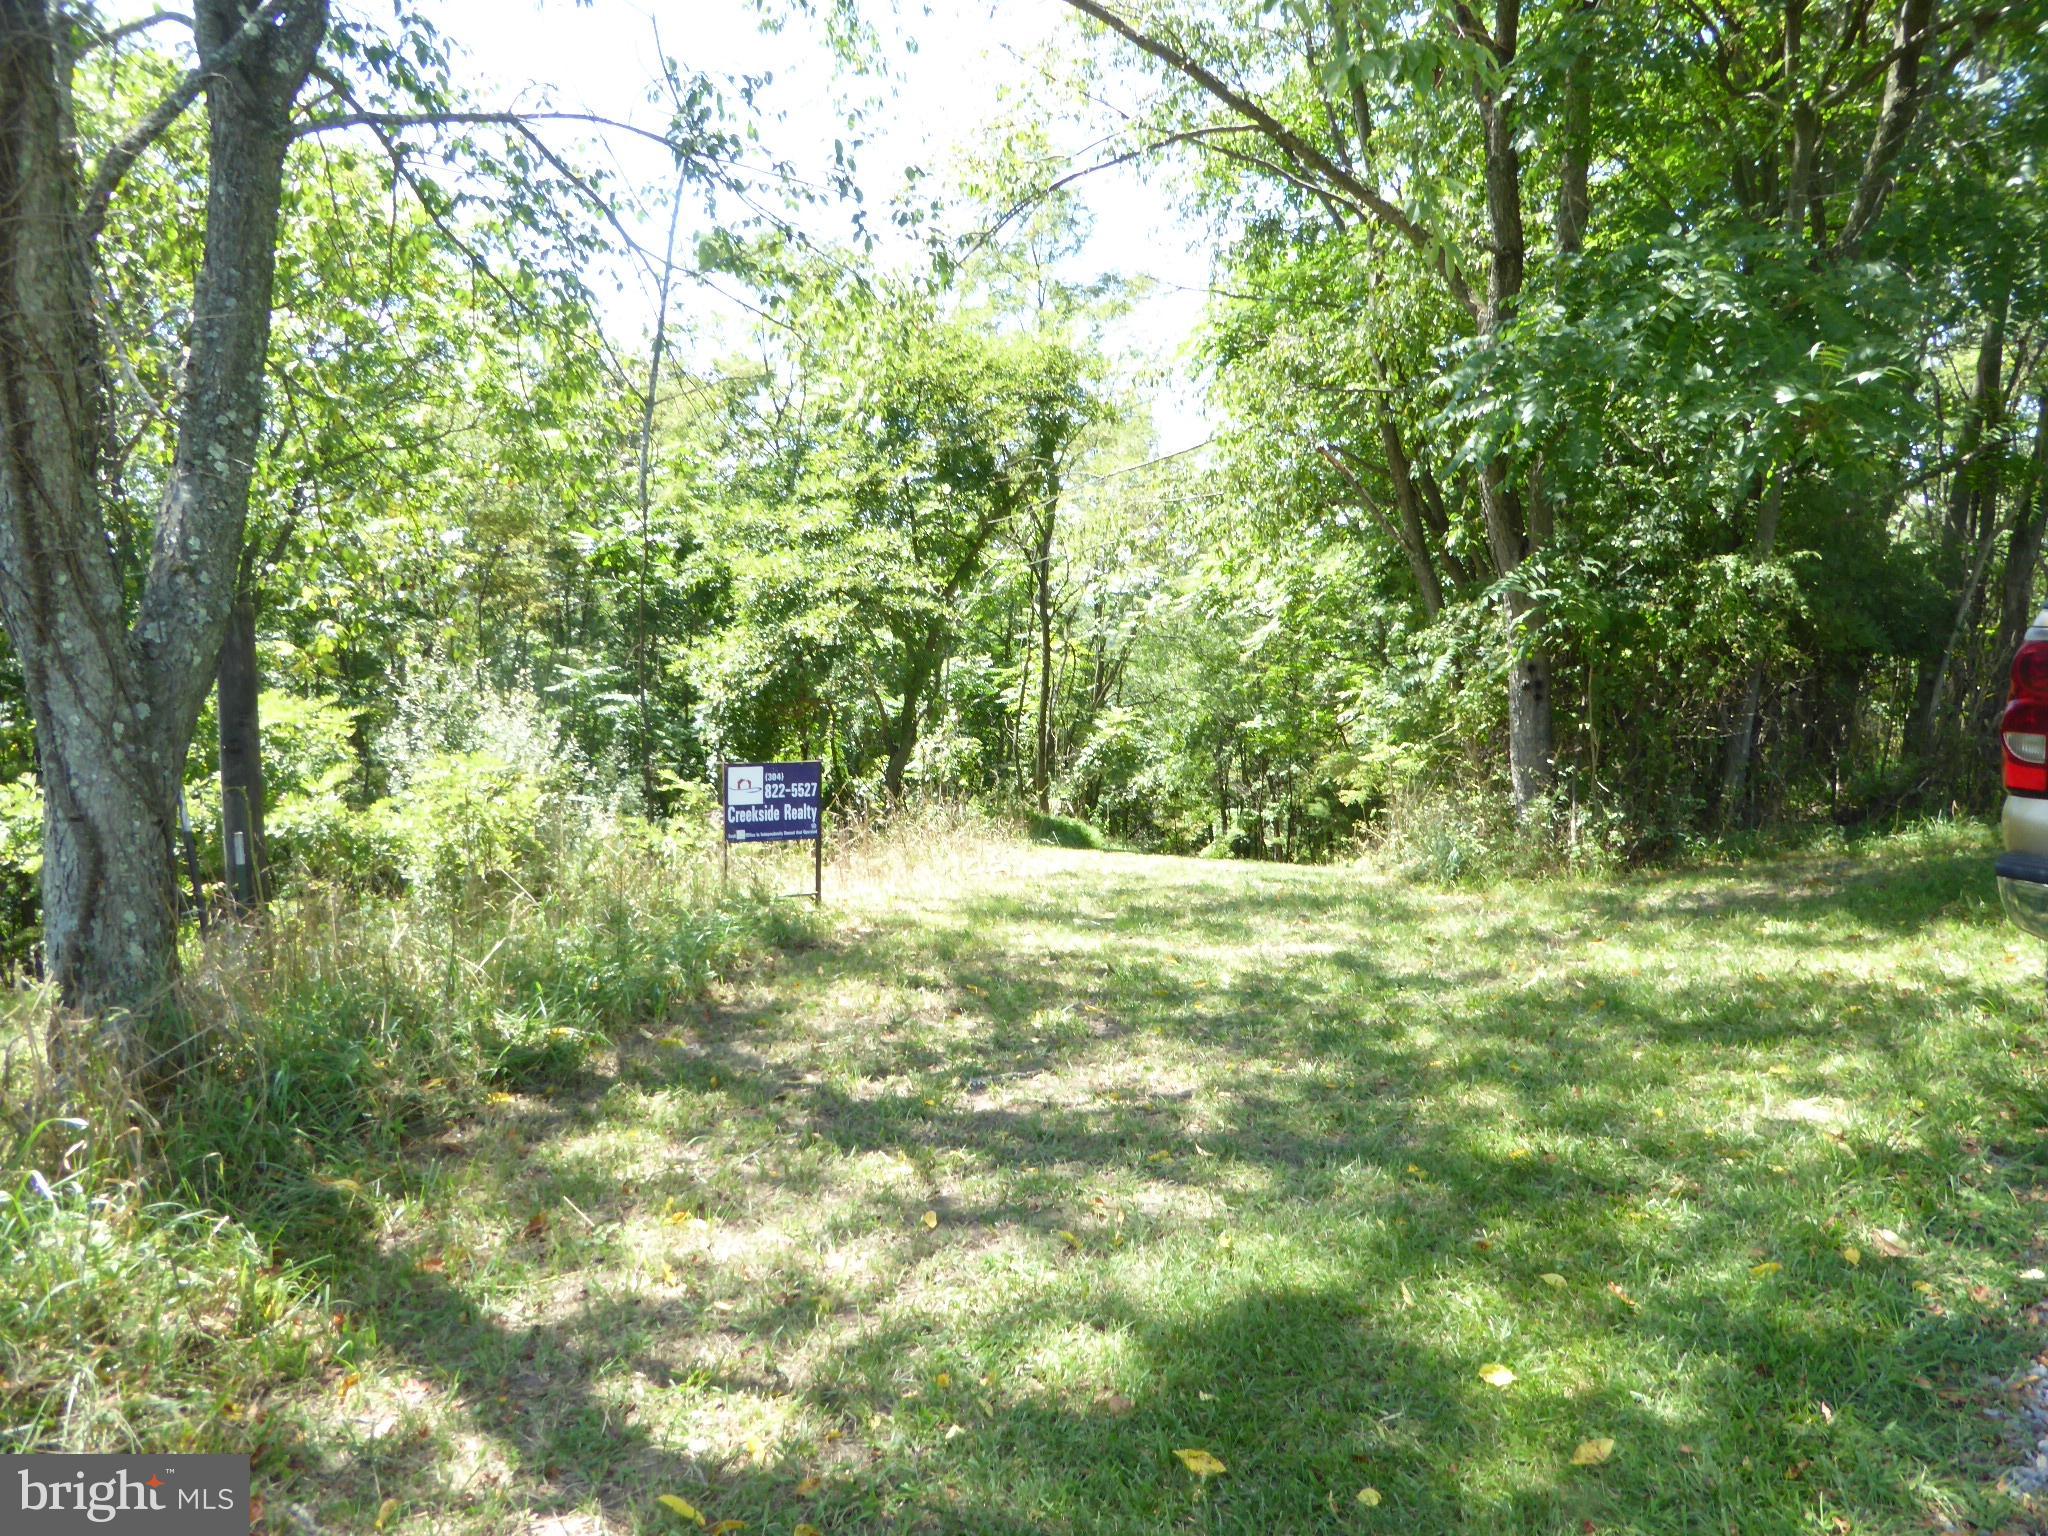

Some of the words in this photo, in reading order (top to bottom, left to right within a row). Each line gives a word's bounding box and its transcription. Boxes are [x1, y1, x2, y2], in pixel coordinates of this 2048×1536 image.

[765, 772, 784, 782] (304)
[765, 782, 818, 799] 822-5527
[728, 804, 780, 824] Creekside
[784, 803, 818, 823] Realty
